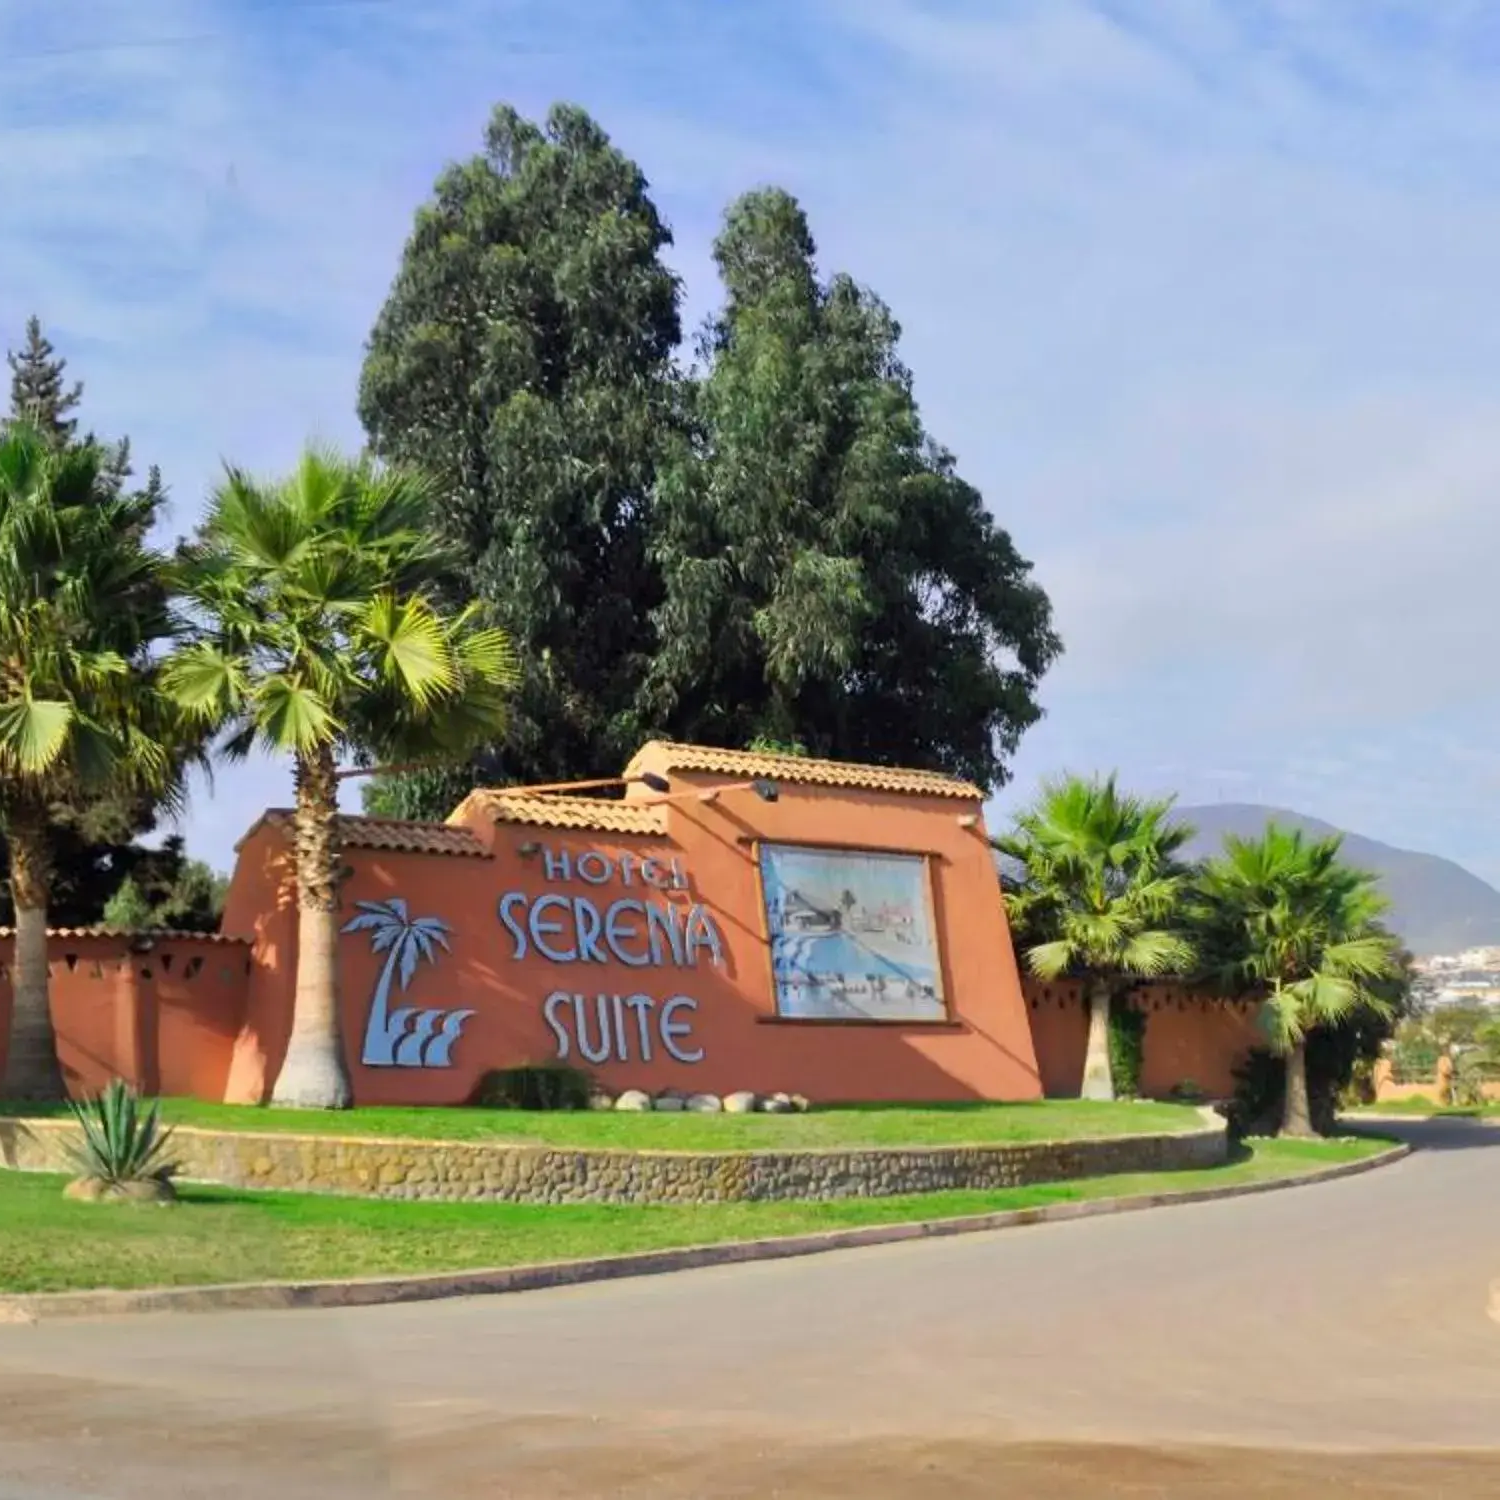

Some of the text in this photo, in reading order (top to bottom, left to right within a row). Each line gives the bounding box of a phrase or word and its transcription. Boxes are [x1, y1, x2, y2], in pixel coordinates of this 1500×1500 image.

[543, 846, 688, 888] HOTEL
[499, 892, 721, 967] SERENA
[543, 990, 704, 1063] SUITE
